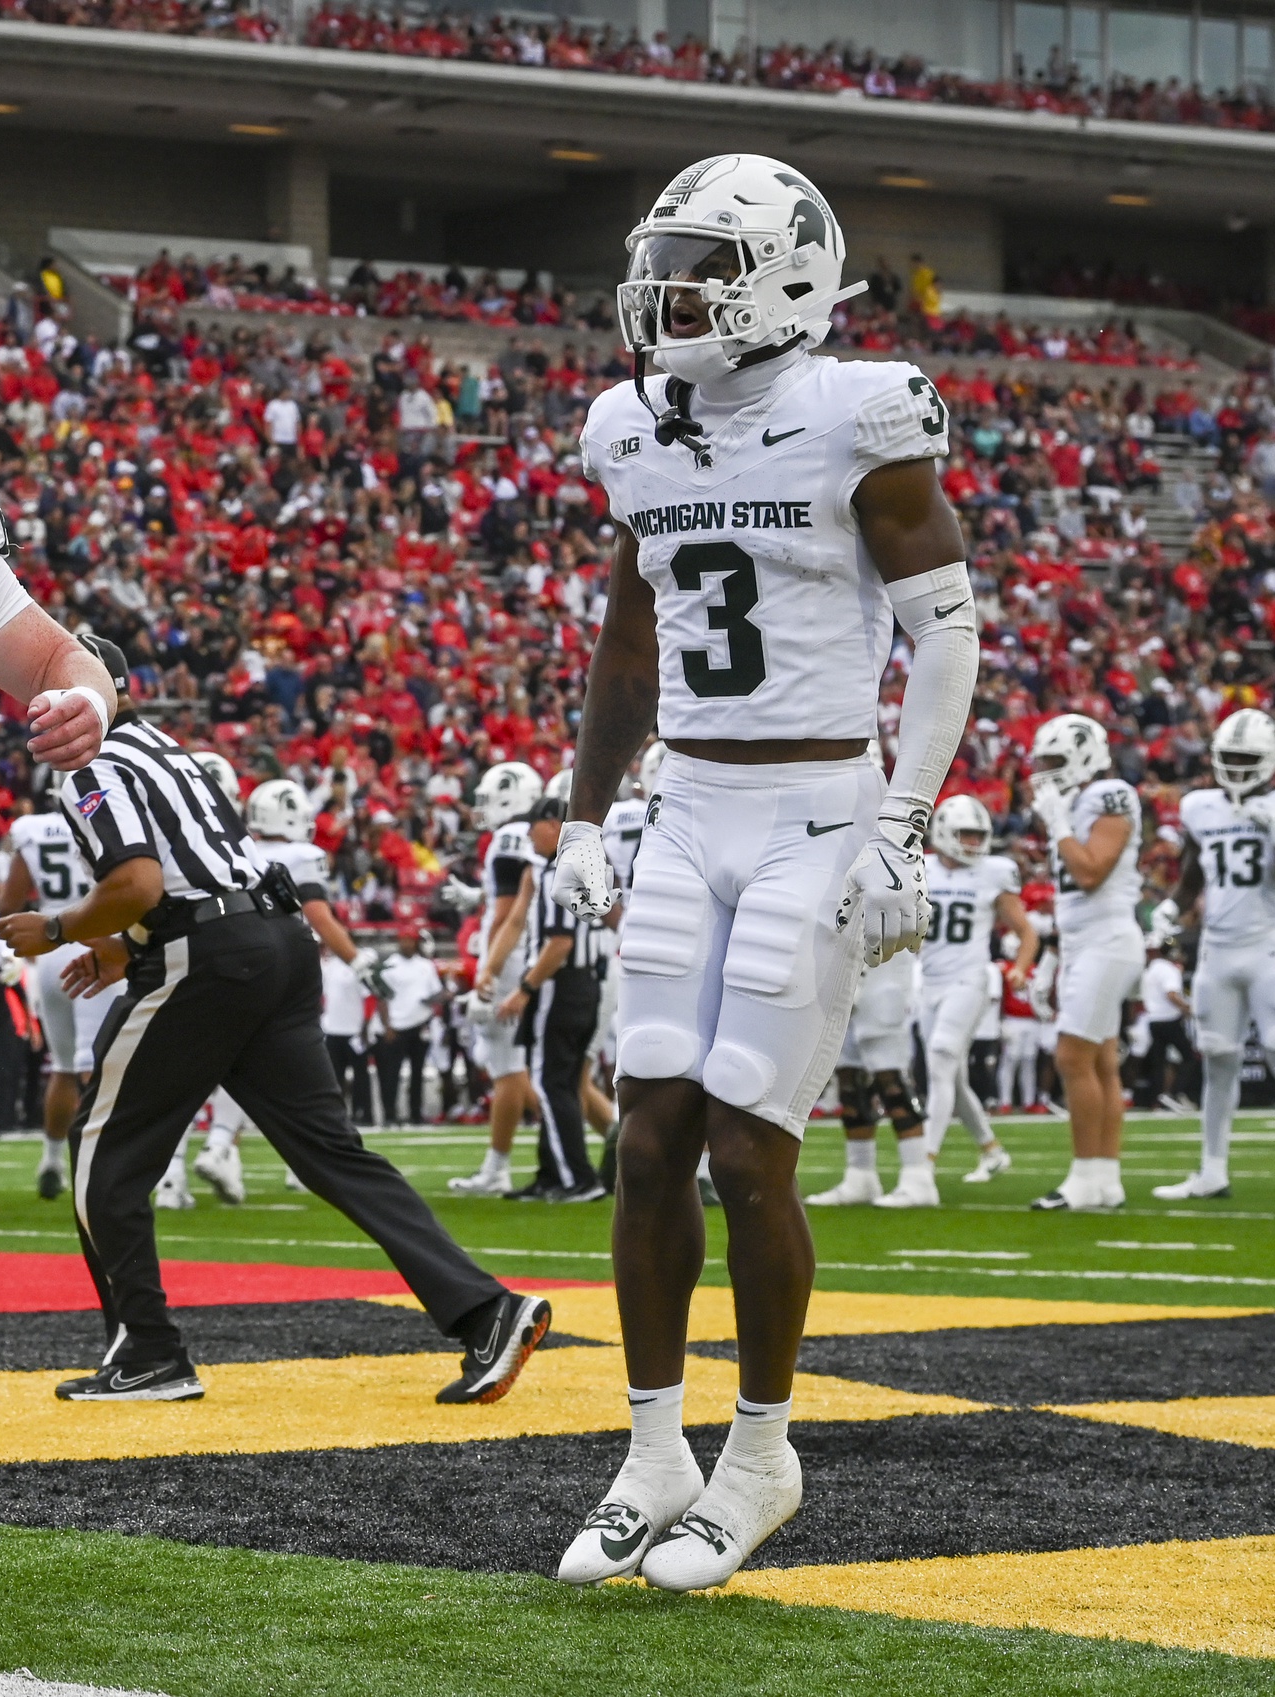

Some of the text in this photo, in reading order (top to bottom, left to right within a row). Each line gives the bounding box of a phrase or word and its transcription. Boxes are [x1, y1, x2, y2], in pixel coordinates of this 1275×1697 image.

[907, 376, 945, 436] 3
[627, 500, 813, 538] MICHIGAN STATE
[670, 541, 767, 698] 3
[38, 842, 90, 899] 5
[1209, 838, 1263, 888] 13
